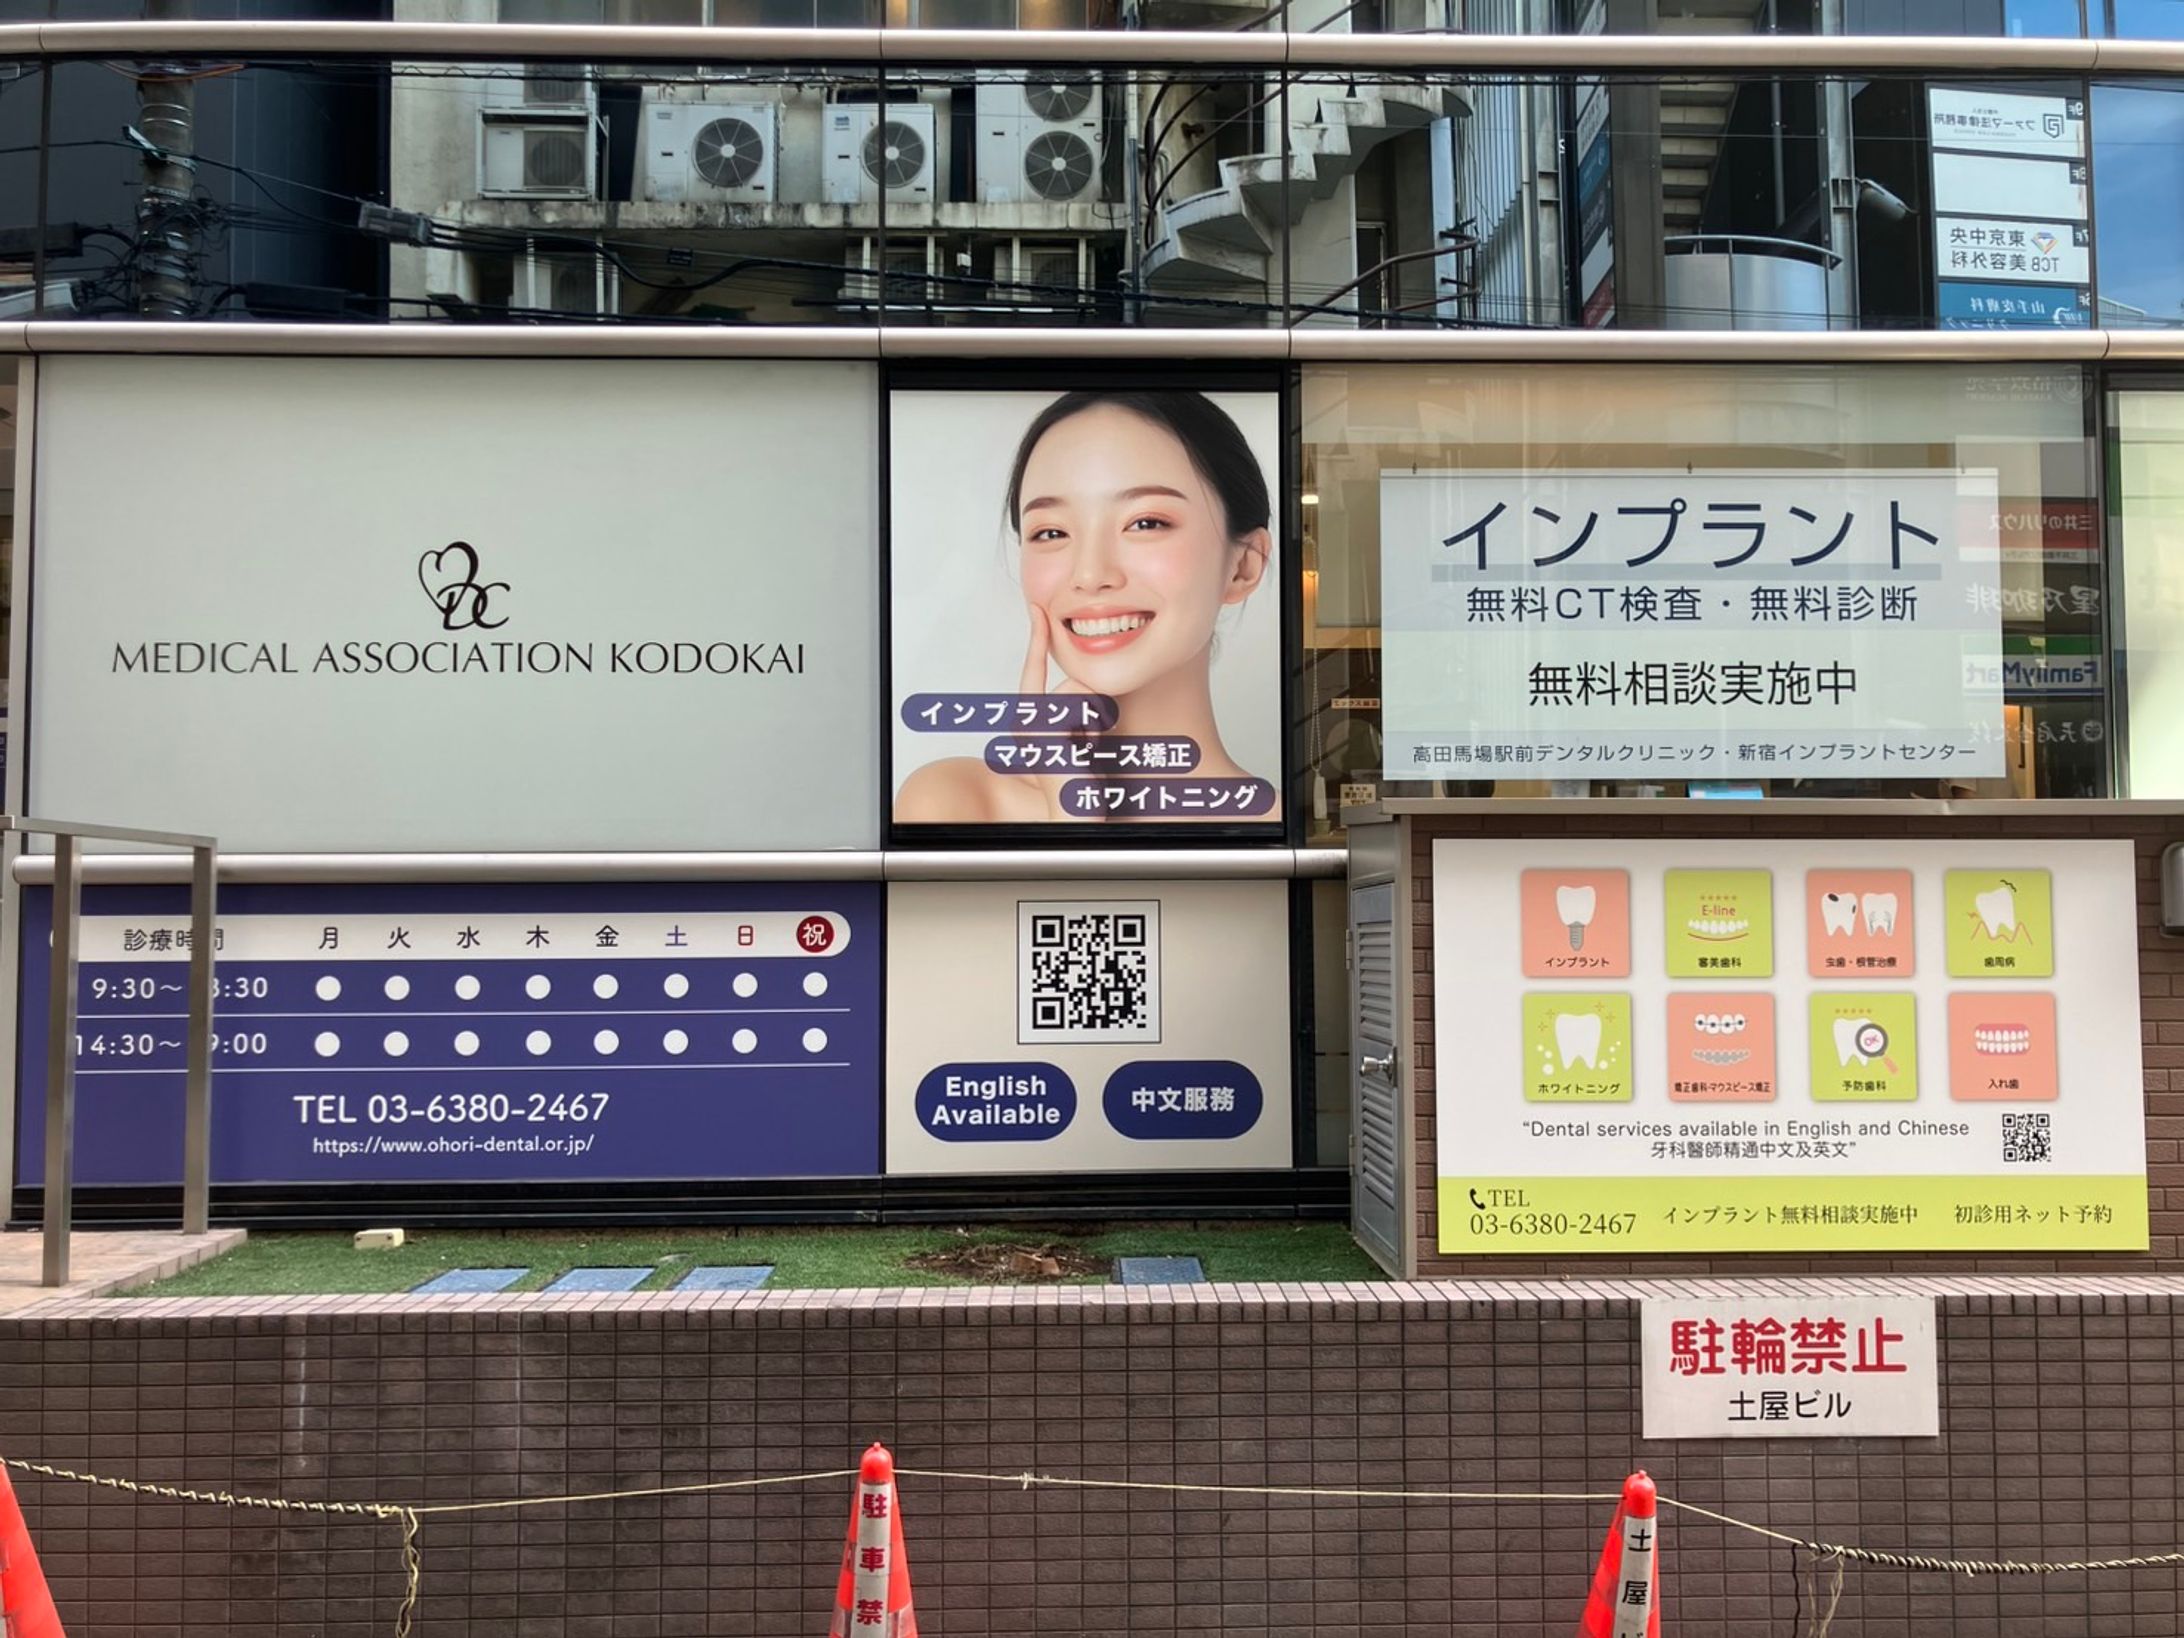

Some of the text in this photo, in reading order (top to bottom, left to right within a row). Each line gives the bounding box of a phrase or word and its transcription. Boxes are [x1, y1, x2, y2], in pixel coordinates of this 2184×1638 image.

[1441, 497, 1939, 571] インプラント
[1466, 585, 1918, 623] 無料CT検査・無料診断
[111, 641, 804, 675] MEDICAL ASSOCIATION KODOKAI
[1528, 660, 1856, 706] 無料相談実施中
[919, 701, 1100, 726] インプラント
[993, 741, 1192, 768] マウスピース矯正
[1075, 783, 1259, 810] ホワイトニング
[1701, 904, 1737, 917] E-line
[318, 926, 338, 950] 月
[387, 926, 411, 949] 火
[456, 925, 481, 949] 水
[526, 925, 550, 949] 木
[595, 925, 619, 947] 金
[665, 925, 688, 947] 土
[737, 925, 754, 946] 日
[802, 923, 827, 947] 祝
[1545, 956, 1610, 968] インプラント
[1697, 956, 1742, 968] 審美歯科
[1984, 956, 2016, 968] 歯周病
[945, 1075, 1047, 1101] English
[1537, 1083, 1621, 1095] ホワイトニング
[1841, 1080, 1887, 1092] 予防歯科
[1987, 1079, 2020, 1090] 入れ歯
[293, 1093, 609, 1124] TEL 03-6380-2467
[1131, 1086, 1235, 1113] 中文服務
[931, 1103, 1061, 1126] Available
[1596, 1120, 1673, 1137] services
[1678, 1120, 1758, 1137] available
[1764, 1120, 1780, 1136] in
[1787, 1120, 1851, 1140] English
[1858, 1120, 1891, 1136] and
[1897, 1119, 1970, 1136] Chinese
[313, 1134, 595, 1158] https://www.ohori-dental.or.jp/
[1487, 1189, 1531, 1208] TEL
[1469, 1213, 1637, 1235] 03-6380-2467
[1663, 1203, 2113, 1225] インプラント無料相談実施中 初診用ネット予約
[1669, 1316, 1908, 1377] 駐輪禁止
[1727, 1388, 1852, 1421] 土屋ビル
